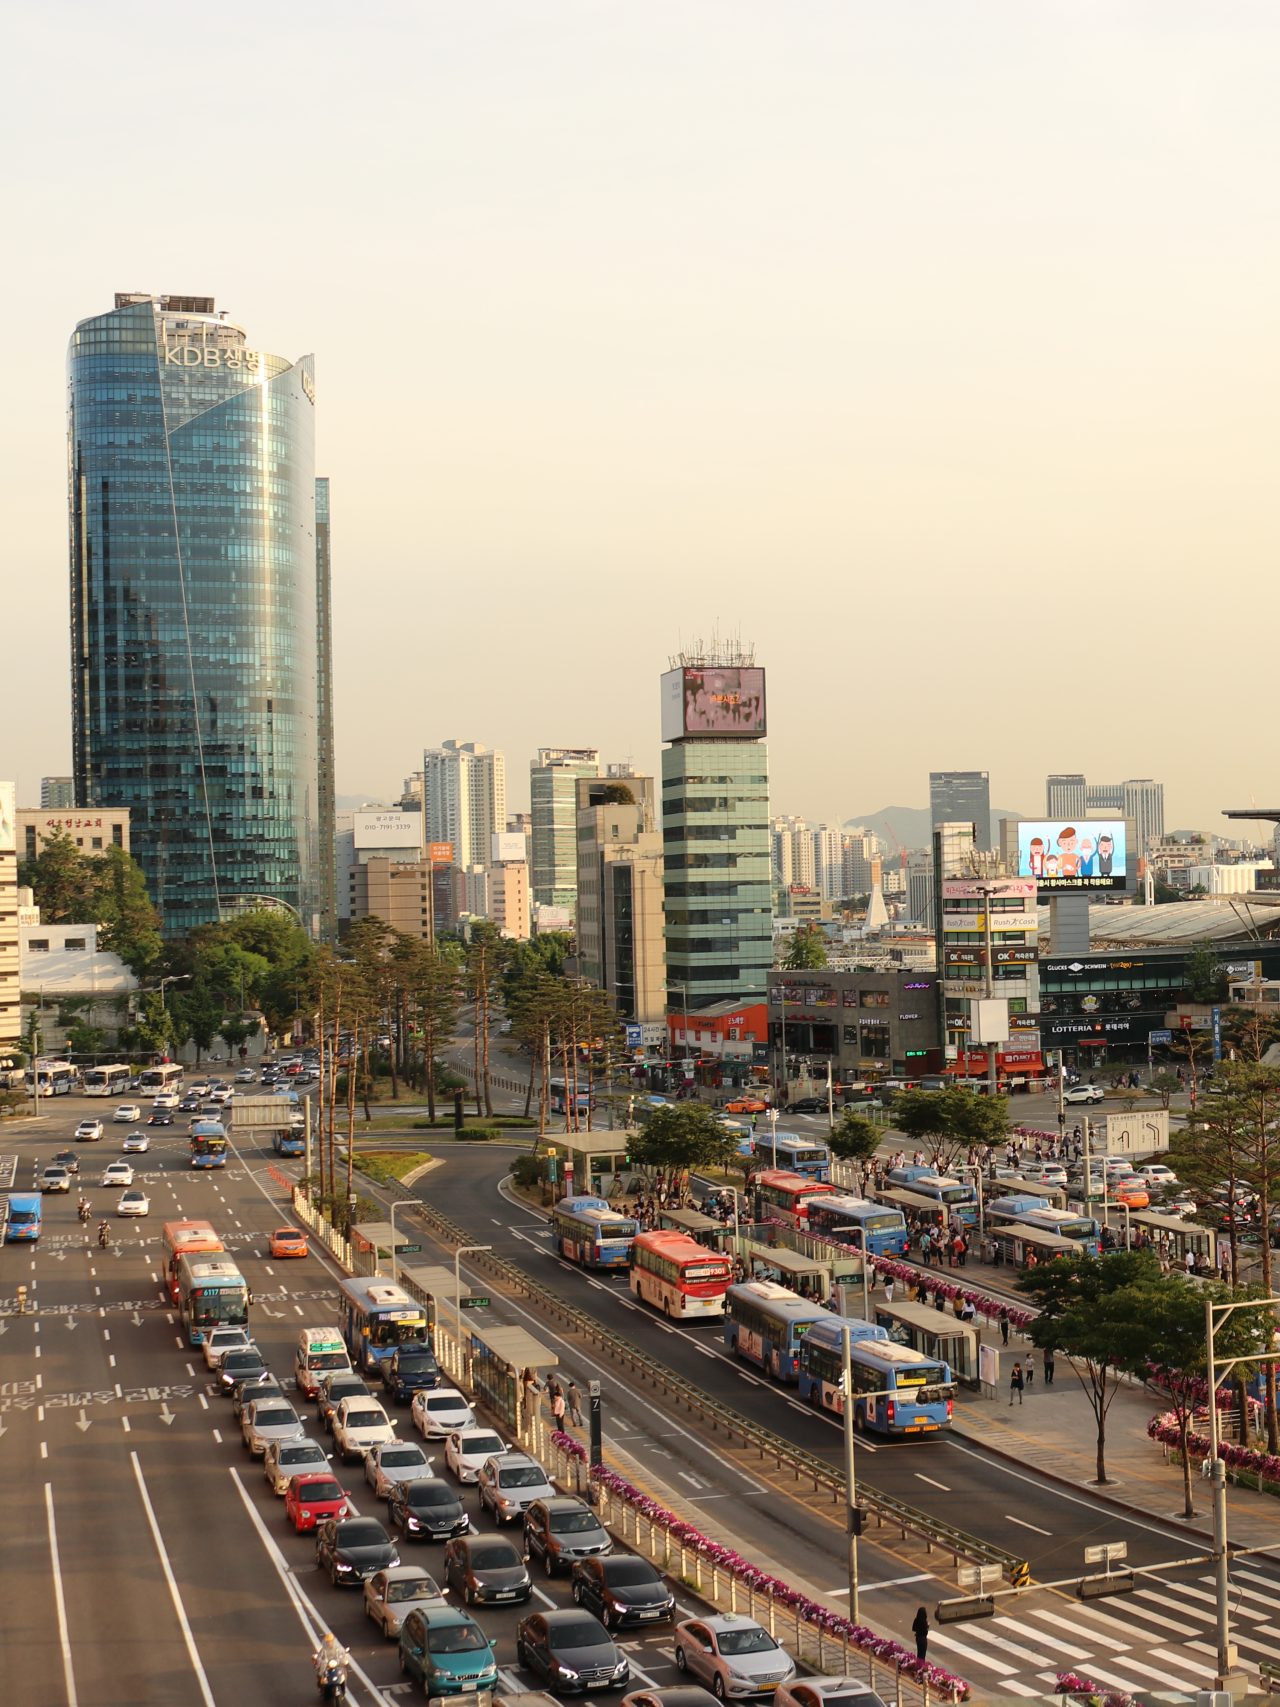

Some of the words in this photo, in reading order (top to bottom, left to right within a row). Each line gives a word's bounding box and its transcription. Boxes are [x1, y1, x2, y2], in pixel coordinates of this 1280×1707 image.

[993, 918, 1011, 926] Rush
[950, 953, 958, 961] OK
[997, 952, 1010, 960] OK
[954, 1018, 963, 1027] OK
[1051, 1025, 1093, 1033] LOTTERIA
[1105, 1022, 1130, 1031] 롯데리아
[709, 1268, 726, 1276] 9301
[203, 1289, 219, 1297] 6117
[124, 1384, 196, 1403] 숭례문
[44, 1390, 116, 1409] 숭례문
[592, 1398, 599, 1409] 7
